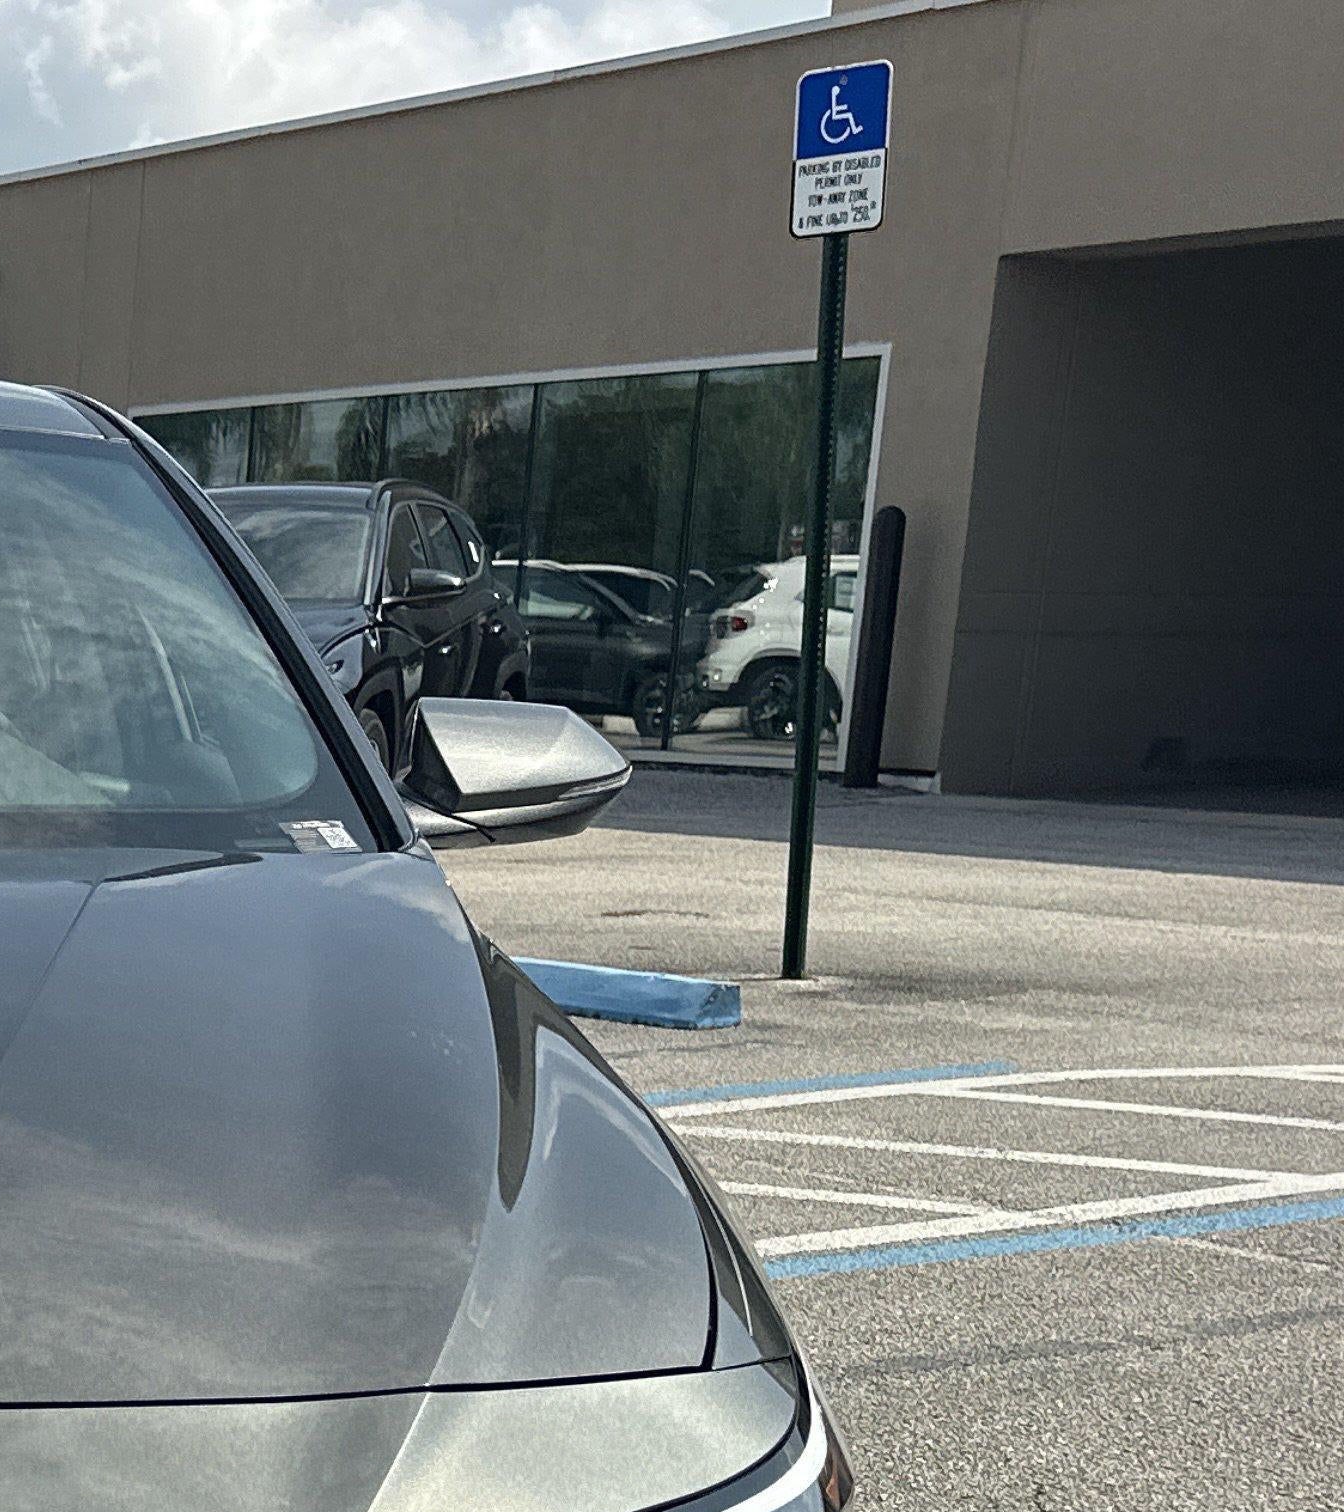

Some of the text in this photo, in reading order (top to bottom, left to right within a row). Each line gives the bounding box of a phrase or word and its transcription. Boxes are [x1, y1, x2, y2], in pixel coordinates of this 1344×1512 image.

[799, 156, 881, 178] PARKING BY DISABLED
[815, 173, 862, 189] PERMIT ONLY
[808, 188, 868, 207] TOW-AWAY ZONE
[807, 214, 823, 228] FINE
